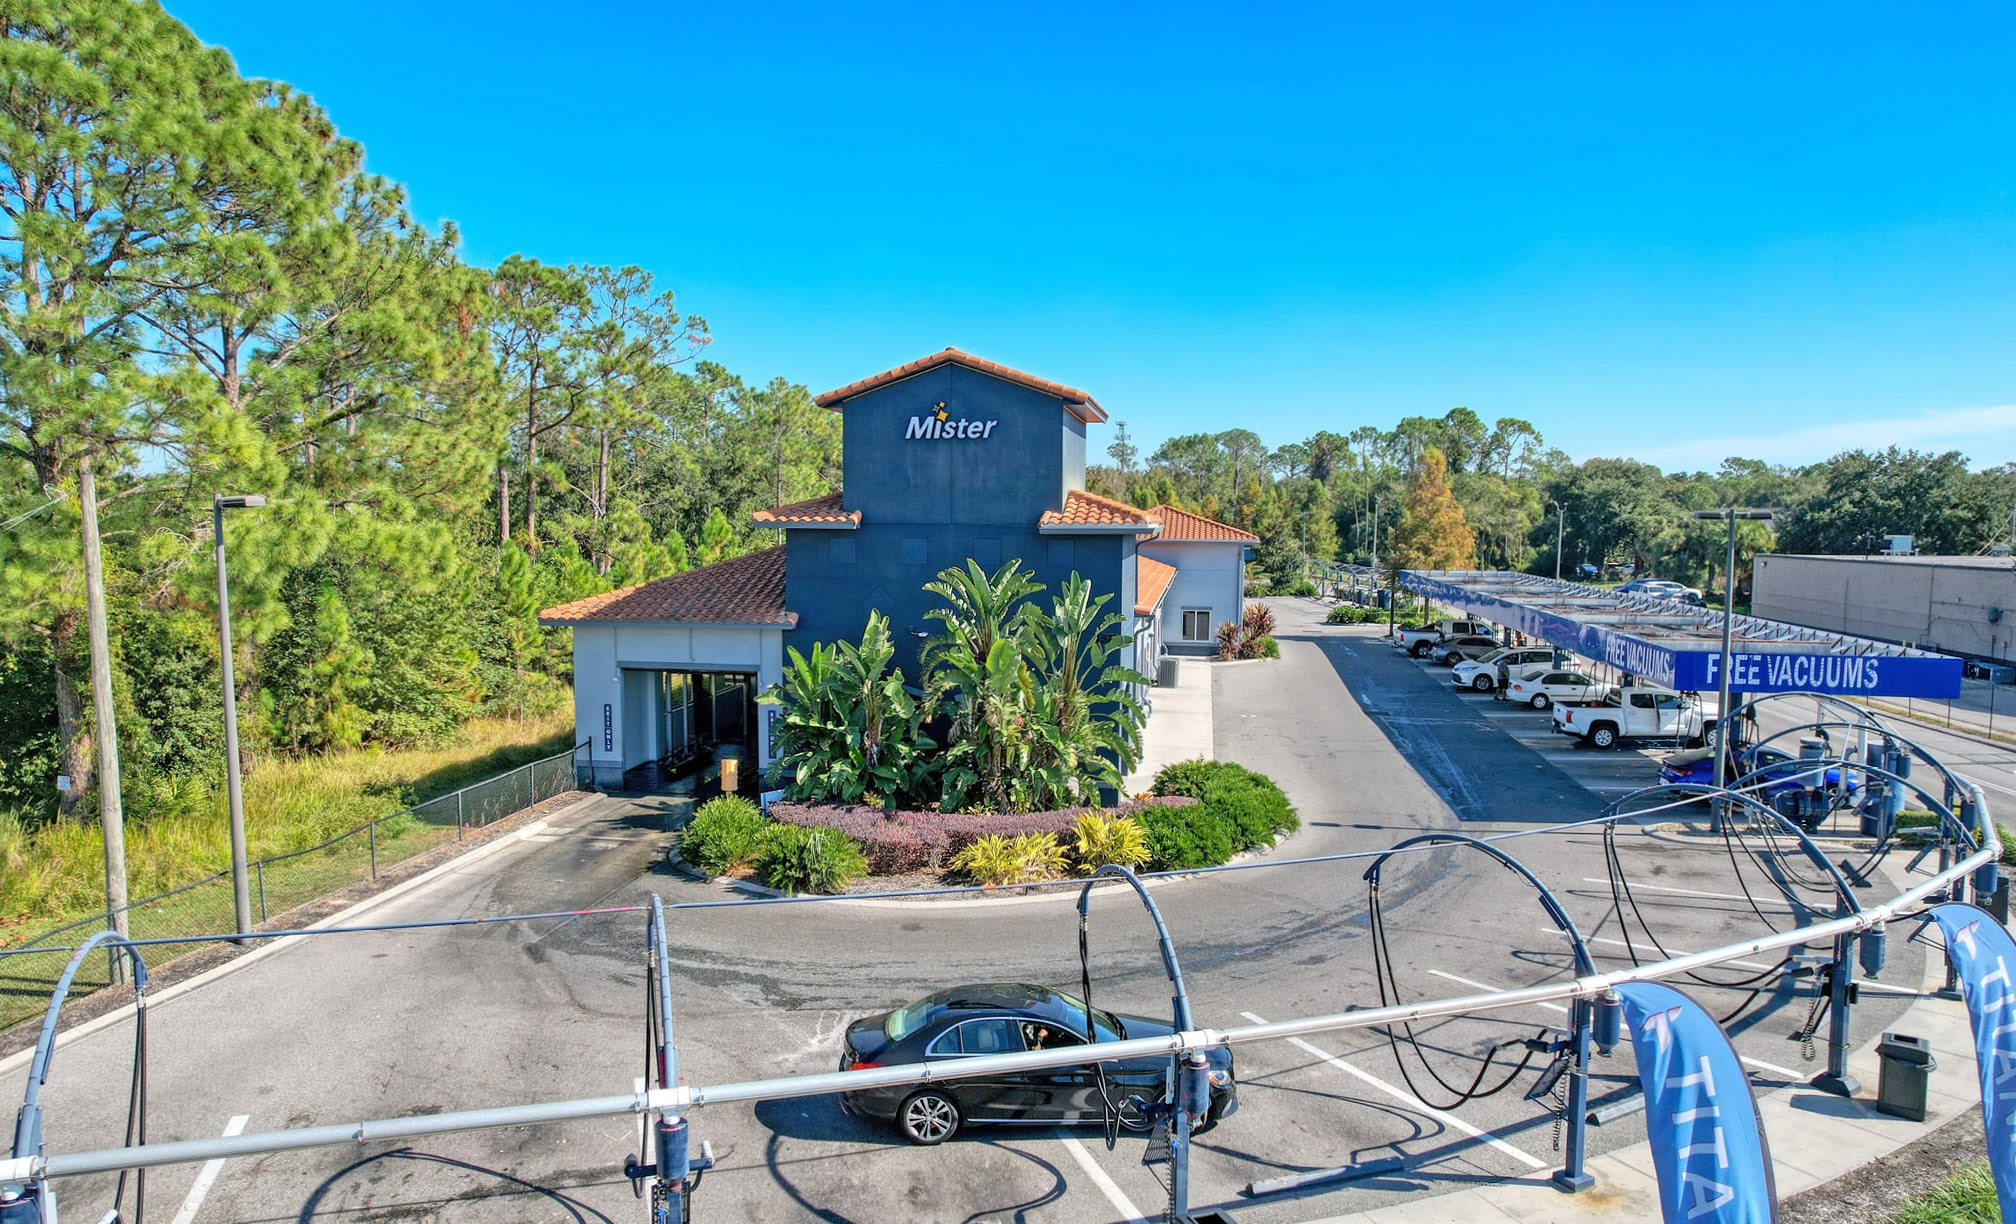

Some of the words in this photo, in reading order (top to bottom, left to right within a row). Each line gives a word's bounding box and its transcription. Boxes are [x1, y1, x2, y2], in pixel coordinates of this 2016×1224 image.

[905, 416, 997, 439] Mister
[1606, 635, 1626, 667] FREE
[1626, 641, 1670, 682] VACUUMS
[1766, 655, 1879, 688] VACUUMS
[1665, 1055, 1735, 1221] TITA
